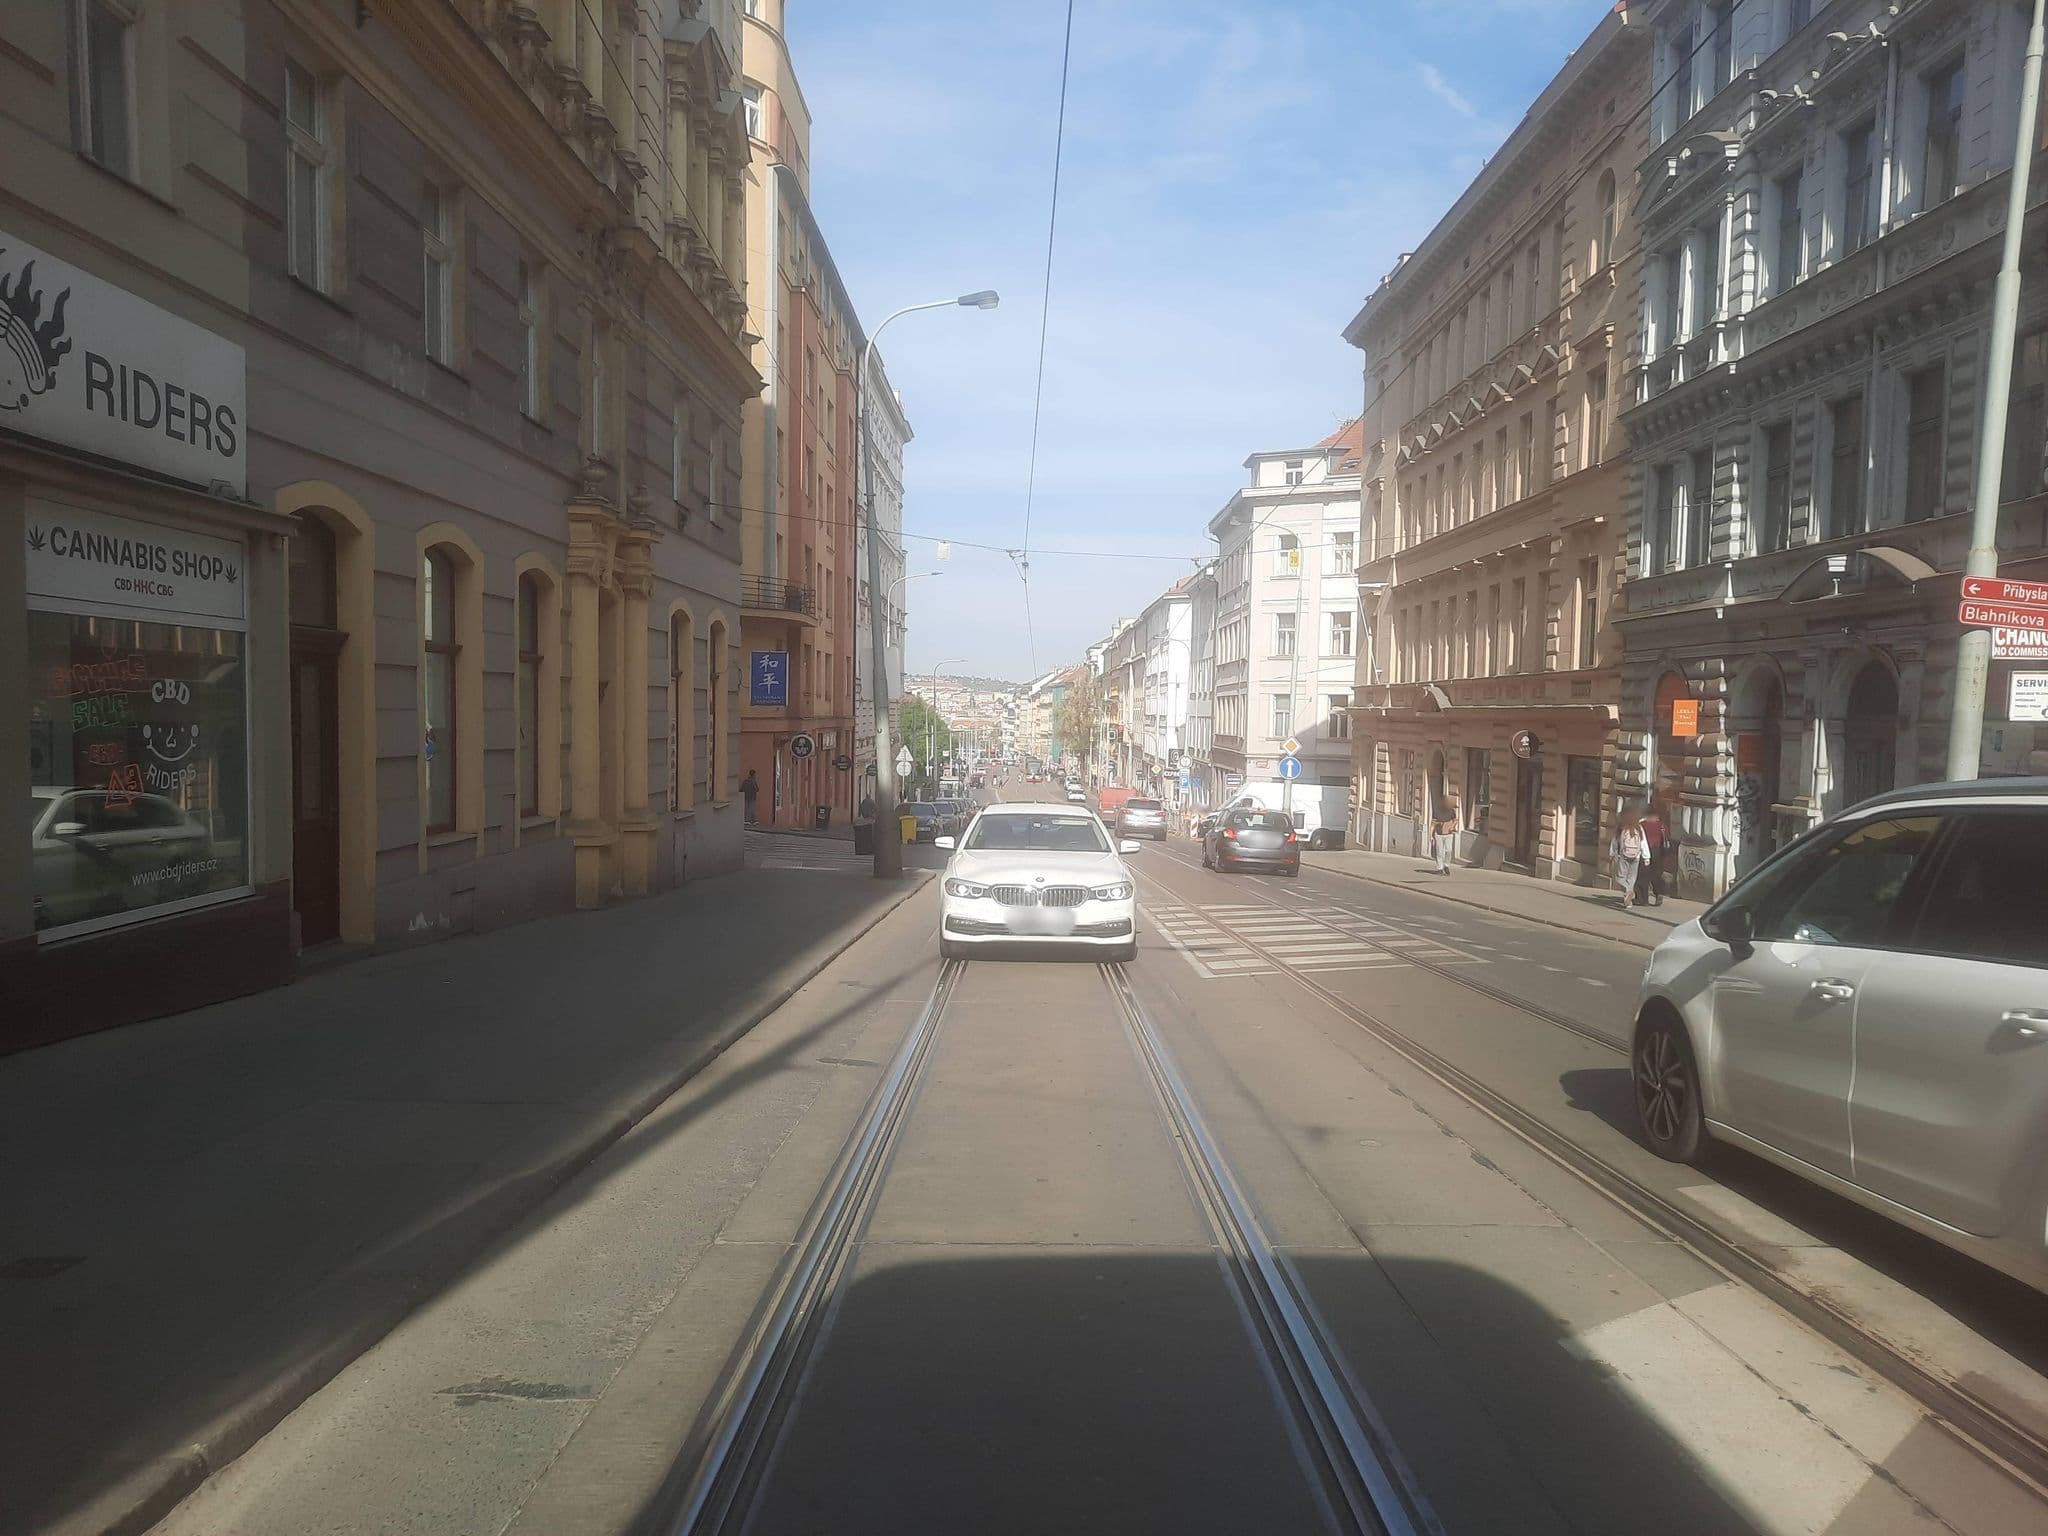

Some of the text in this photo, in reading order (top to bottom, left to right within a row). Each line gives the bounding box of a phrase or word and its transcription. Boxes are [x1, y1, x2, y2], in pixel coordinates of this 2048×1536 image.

[85, 351, 236, 457] RIDERS
[50, 526, 223, 581] CANNABIS SHOP
[114, 578, 174, 597] CBD HHC CBG
[1965, 606, 2045, 626] Blahníkova
[1994, 646, 2007, 656] NO
[151, 678, 191, 705] CBD
[2016, 679, 2048, 687] SERVI
[146, 762, 196, 790] RIDERS
